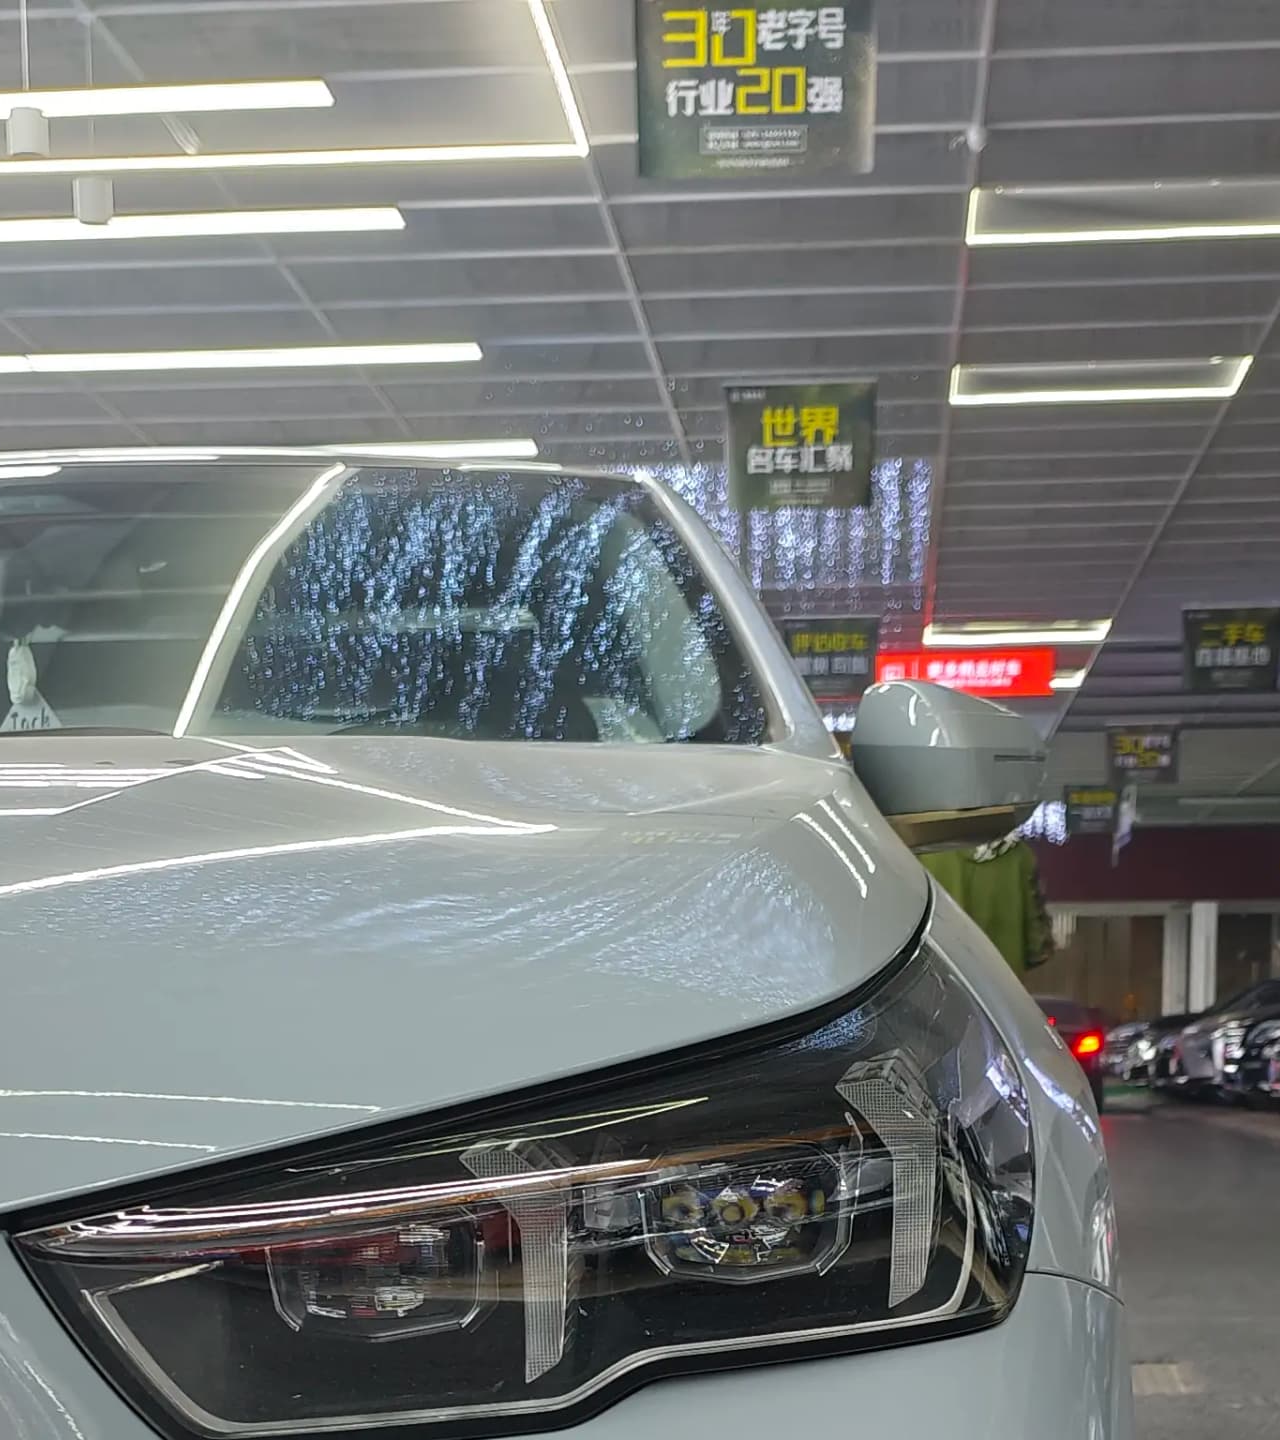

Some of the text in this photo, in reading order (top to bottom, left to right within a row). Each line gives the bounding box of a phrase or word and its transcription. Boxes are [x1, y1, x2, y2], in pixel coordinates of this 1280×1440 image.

[666, 67, 843, 117] 行业20强
[760, 405, 839, 447] 世界
